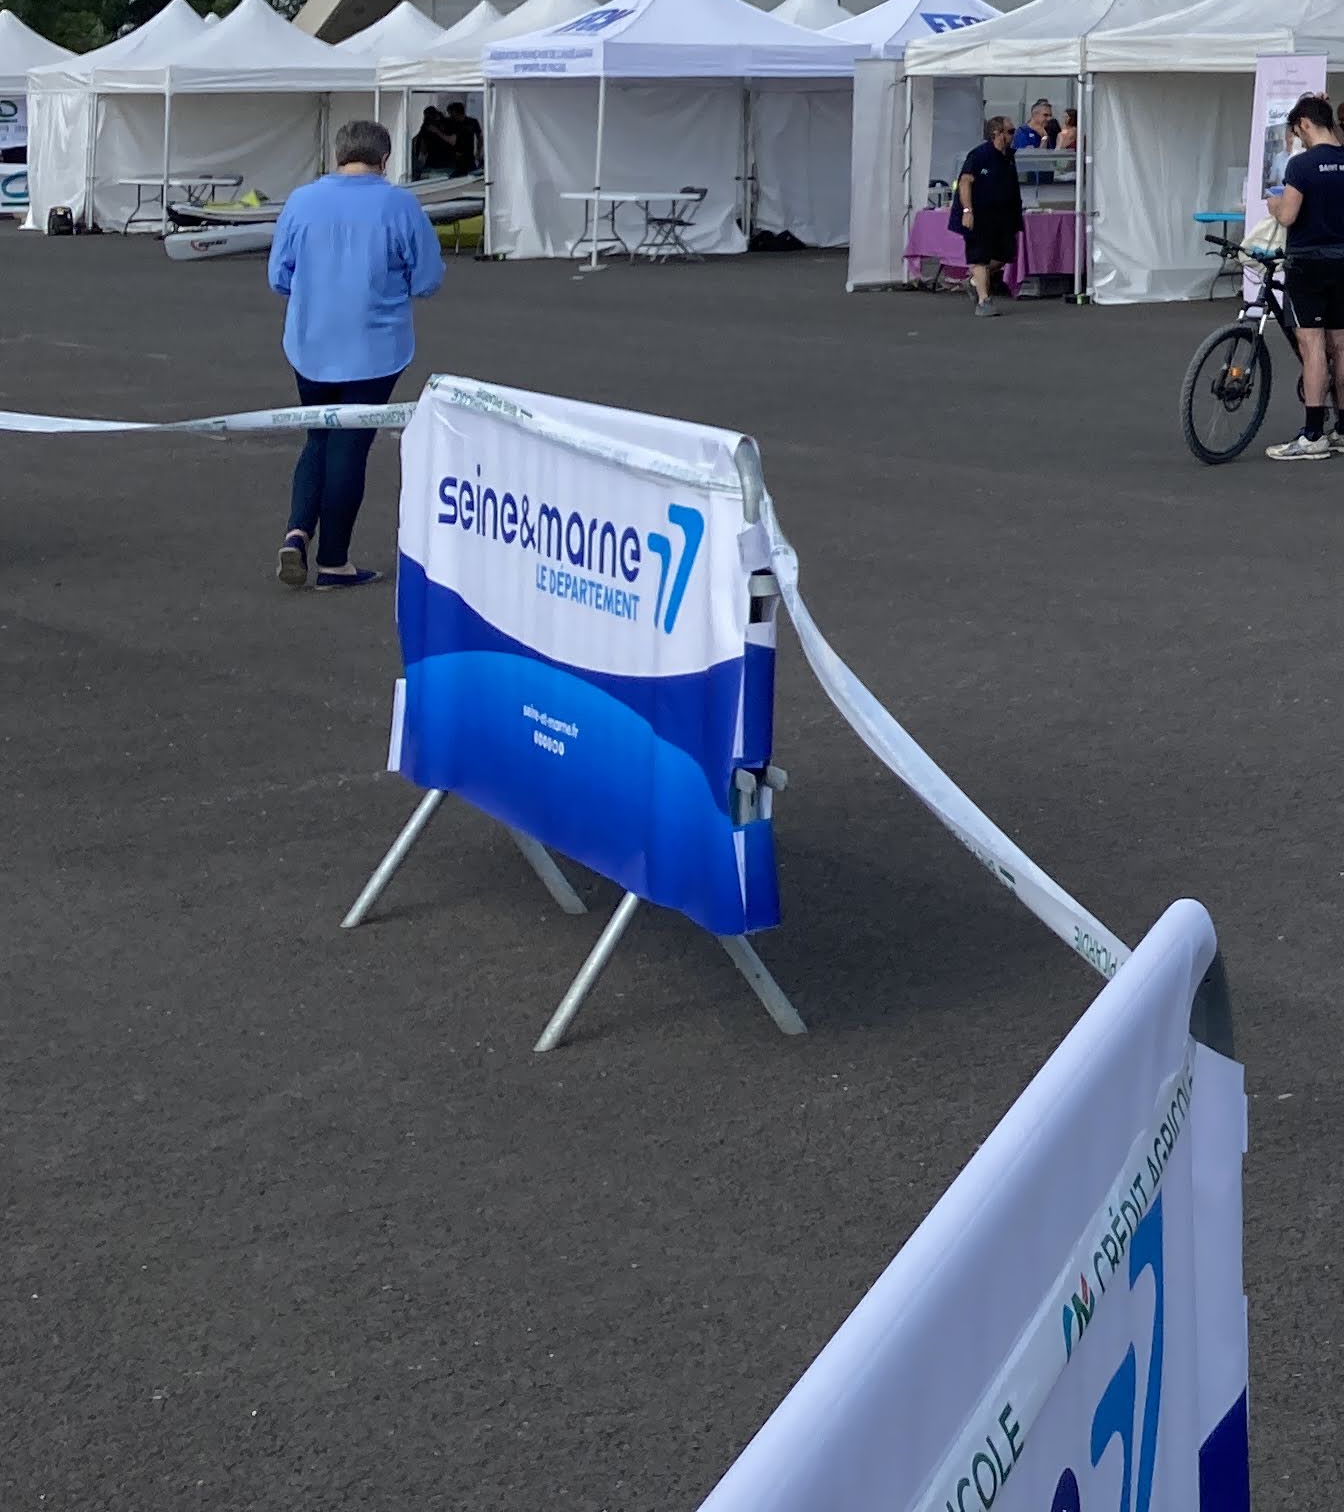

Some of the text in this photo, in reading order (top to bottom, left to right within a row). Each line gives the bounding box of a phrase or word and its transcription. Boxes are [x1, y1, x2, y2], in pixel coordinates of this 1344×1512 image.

[437, 463, 642, 583] seine&marne
[536, 562, 640, 622] LE DÉPARTEMENT
[1093, 1172, 1149, 1294] CRÉDIT
